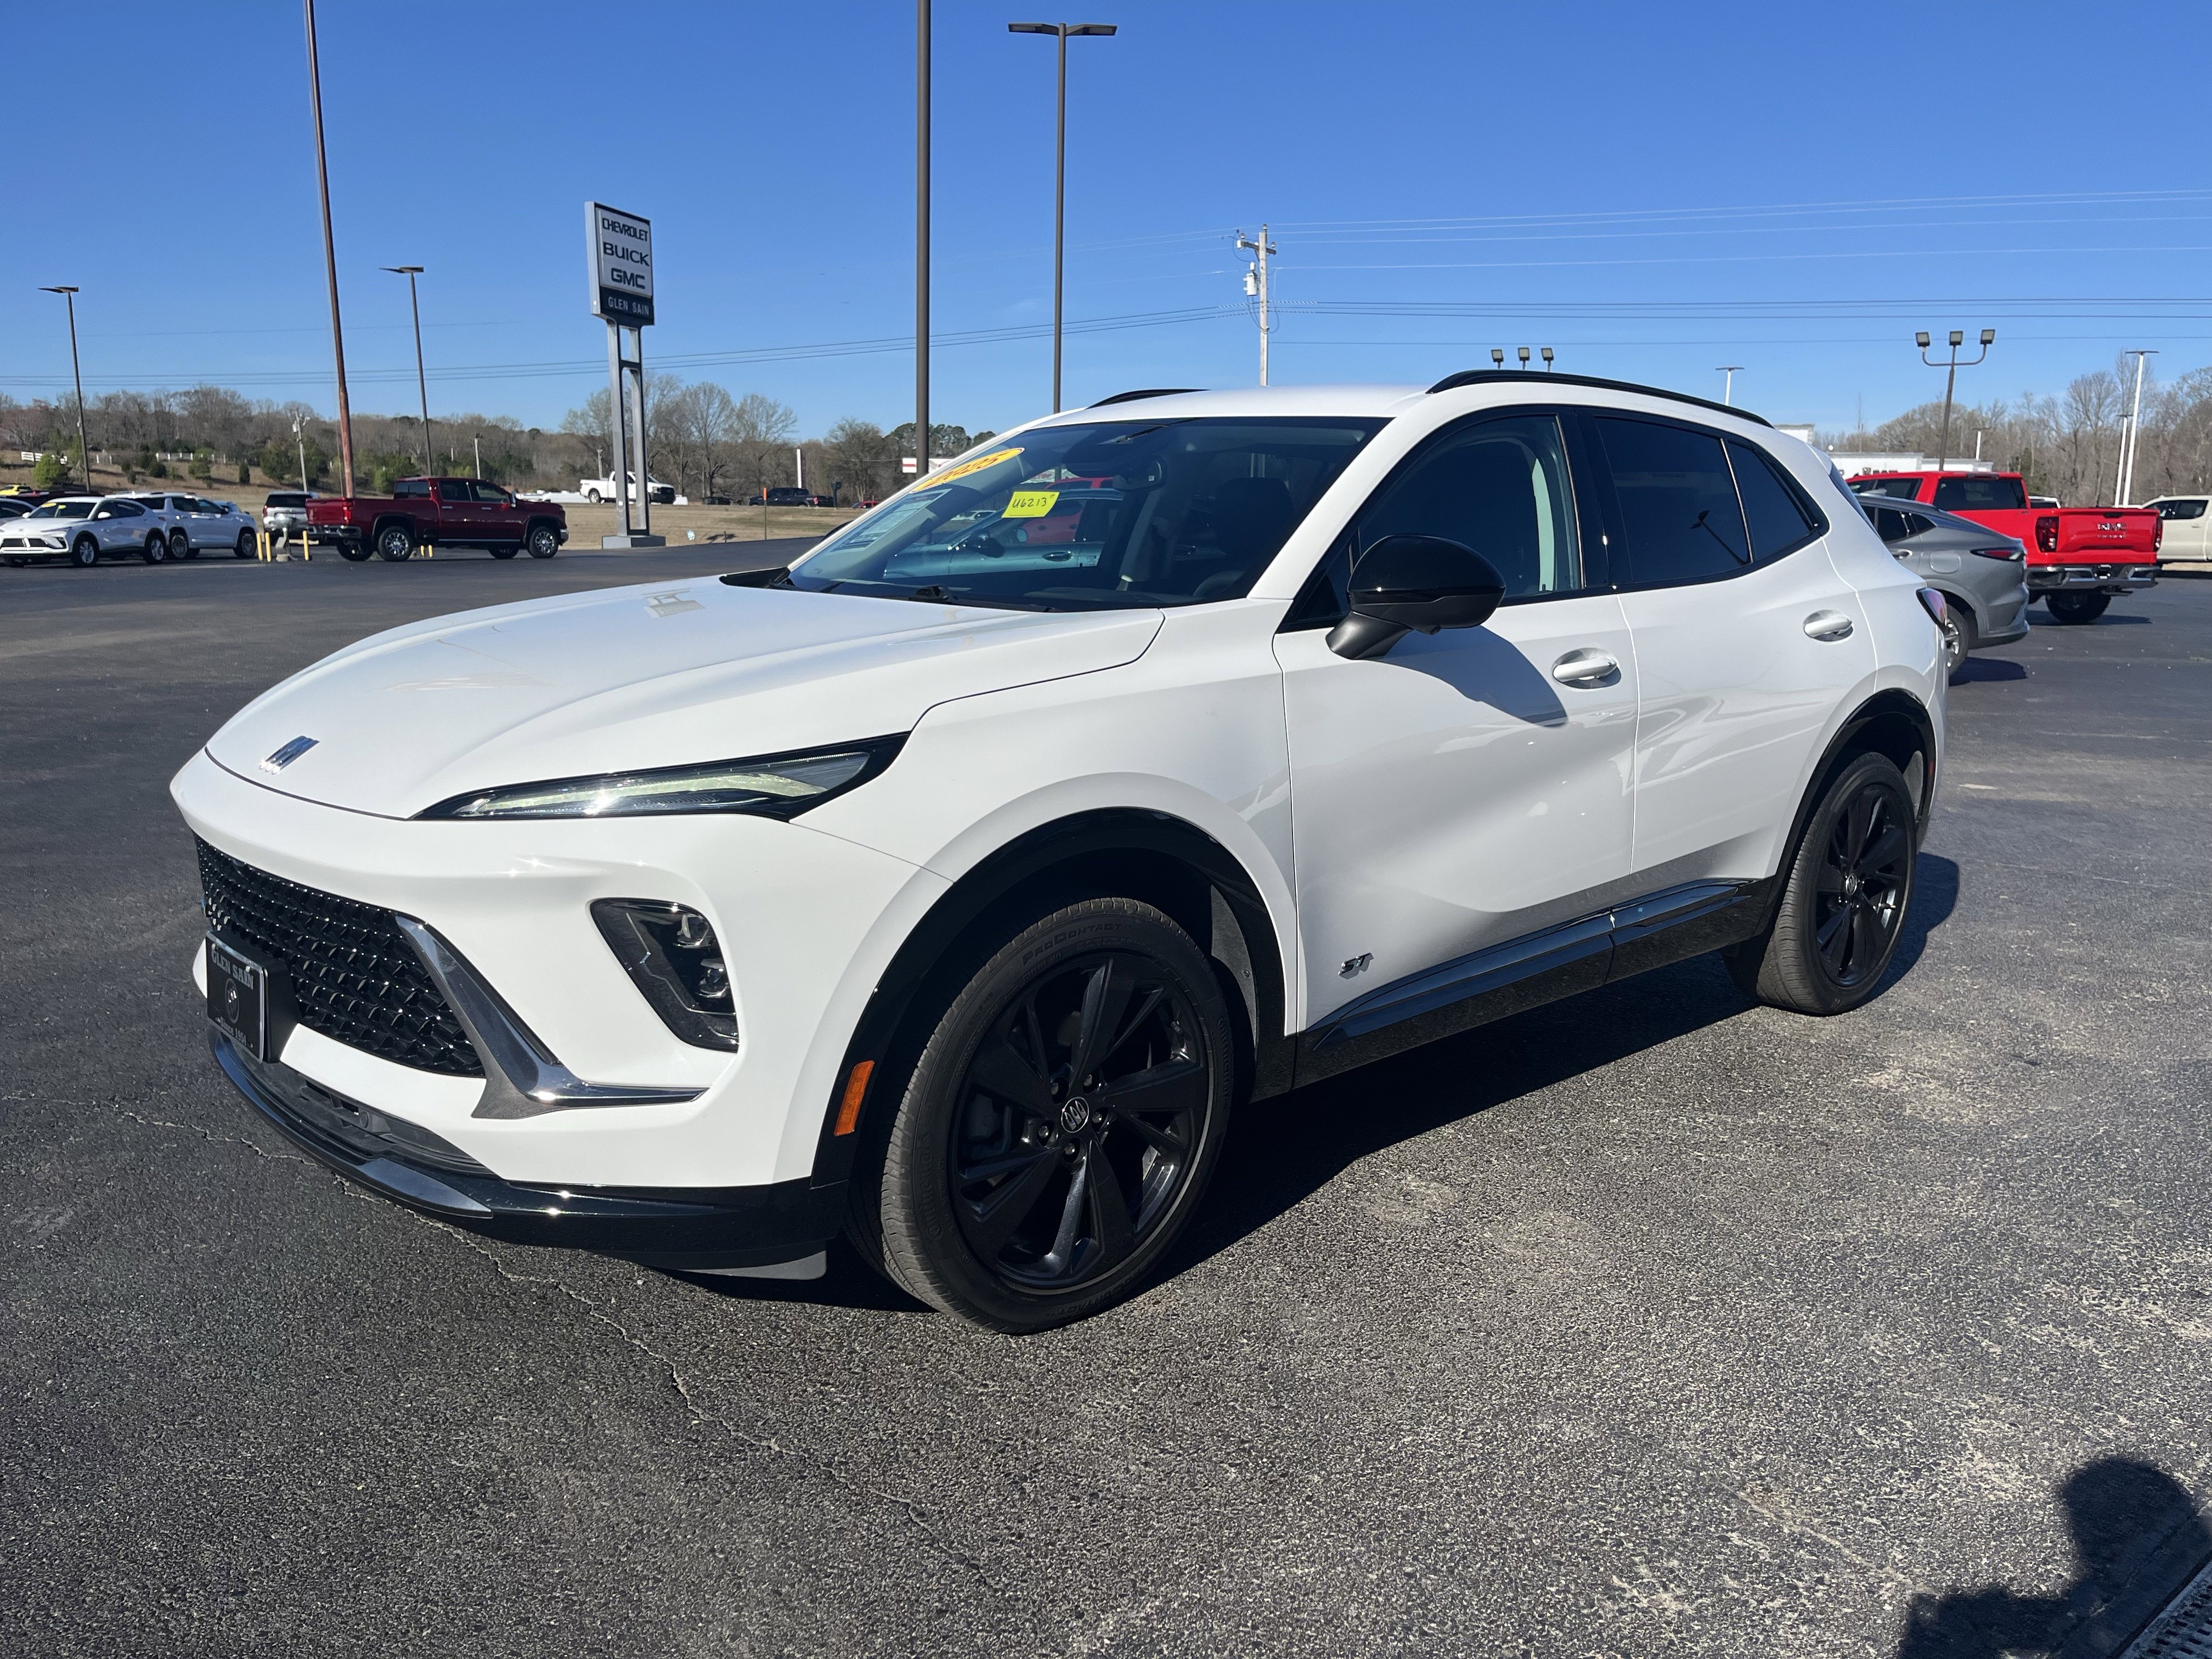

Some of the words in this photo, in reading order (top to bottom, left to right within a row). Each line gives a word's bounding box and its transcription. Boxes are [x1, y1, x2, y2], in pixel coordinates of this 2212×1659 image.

[603, 218, 648, 241] CHEVROLET
[603, 242, 650, 266] BUICK
[611, 267, 645, 289] GMC
[608, 296, 628, 311] GLEN
[633, 302, 650, 315] SAIN
[211, 949, 230, 974] GLEN
[232, 964, 253, 990] SAIN
